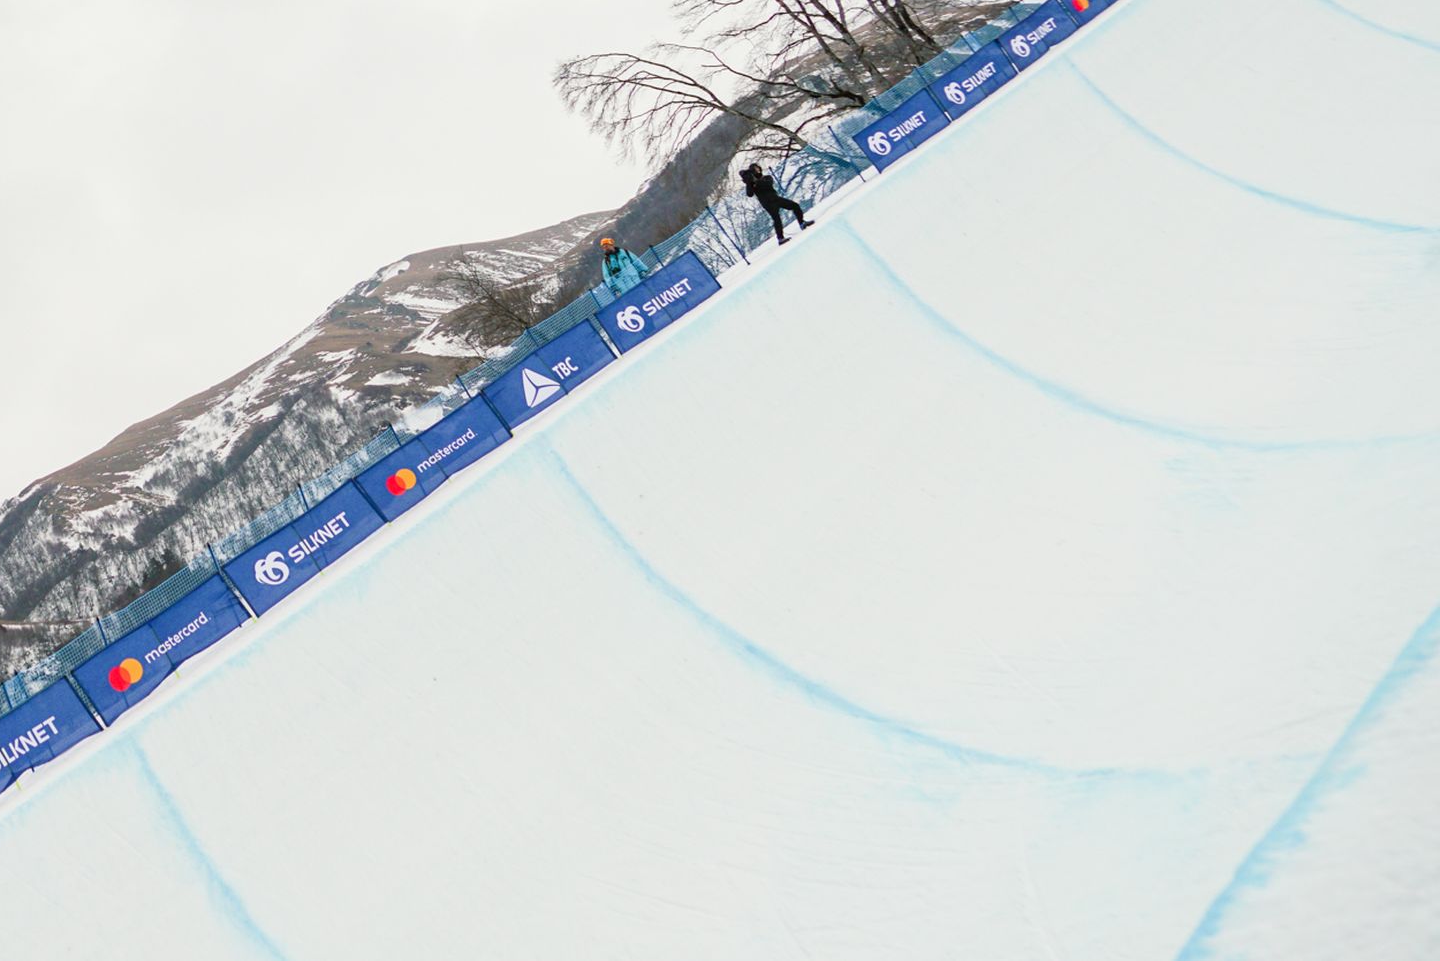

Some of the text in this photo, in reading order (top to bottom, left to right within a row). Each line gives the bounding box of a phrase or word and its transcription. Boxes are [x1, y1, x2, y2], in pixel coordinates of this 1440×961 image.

[642, 278, 692, 317] SILKNET
[552, 357, 579, 380] TBC
[417, 428, 476, 473] mastercard
[288, 512, 351, 564] SILKNET
[145, 611, 210, 664] mastercard
